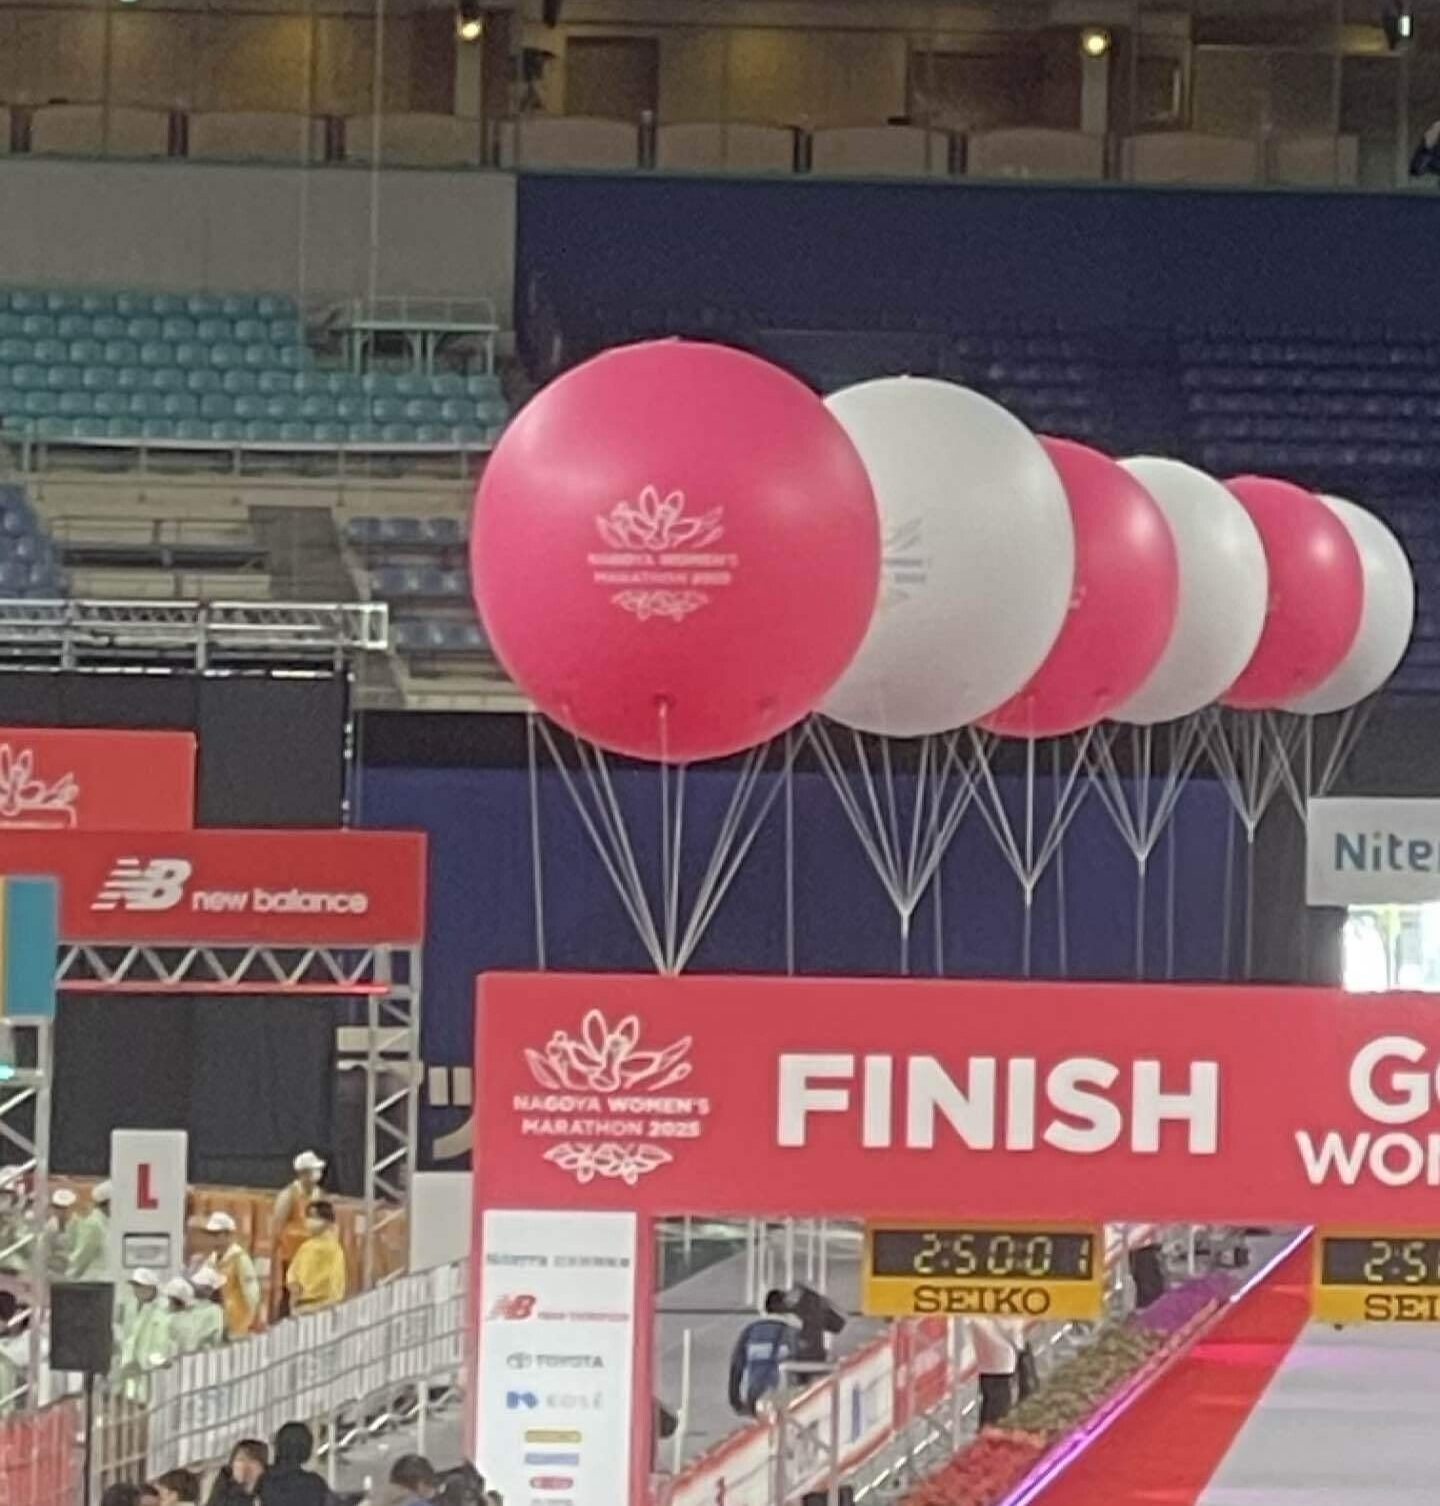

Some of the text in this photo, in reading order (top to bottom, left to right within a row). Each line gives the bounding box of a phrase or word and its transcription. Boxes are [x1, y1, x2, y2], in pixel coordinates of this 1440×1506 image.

[192, 891, 249, 911] new
[253, 888, 369, 914] balance
[513, 1095, 710, 1116] NAGOYA WOMEN'S
[776, 1052, 1219, 1155] FINISH
[521, 1118, 644, 1137] MARATHON
[137, 1163, 159, 1210] L
[913, 1284, 1051, 1316] SEIKO
[536, 1353, 605, 1369] TOYOTA
